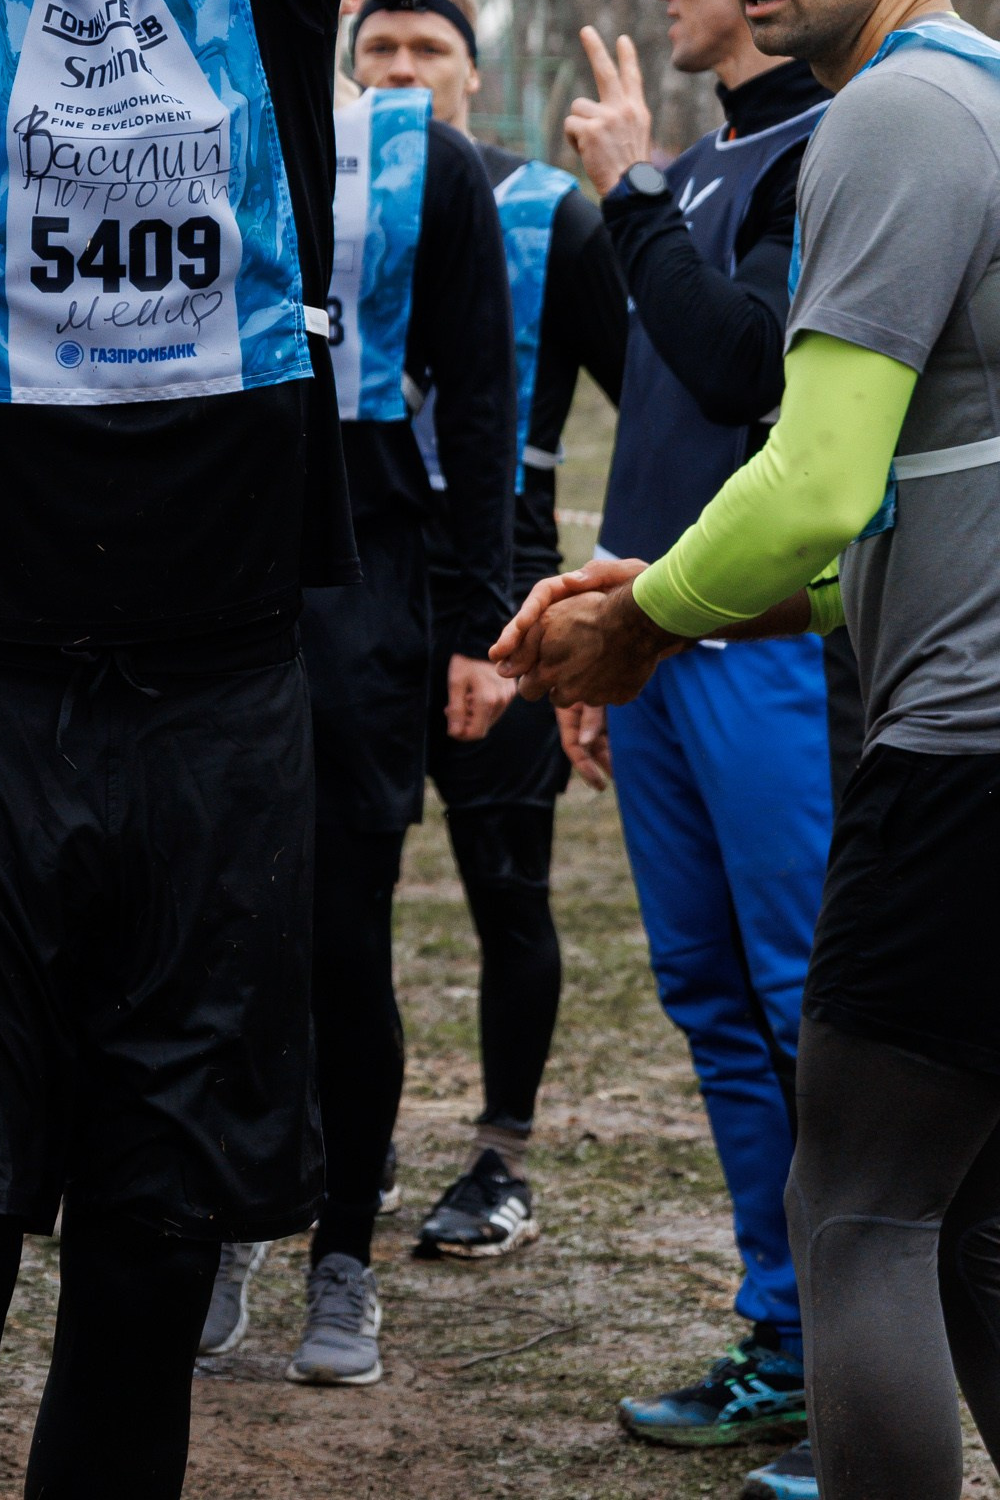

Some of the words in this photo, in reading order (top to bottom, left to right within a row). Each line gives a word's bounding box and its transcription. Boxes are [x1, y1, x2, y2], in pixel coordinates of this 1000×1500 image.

[60, 46, 157, 89] Smin
[50, 117, 85, 130] FINE
[91, 110, 192, 131] DEVELOPMENT
[30, 215, 221, 294] 5409
[90, 342, 198, 364] ГАЗПРОМБАНК
